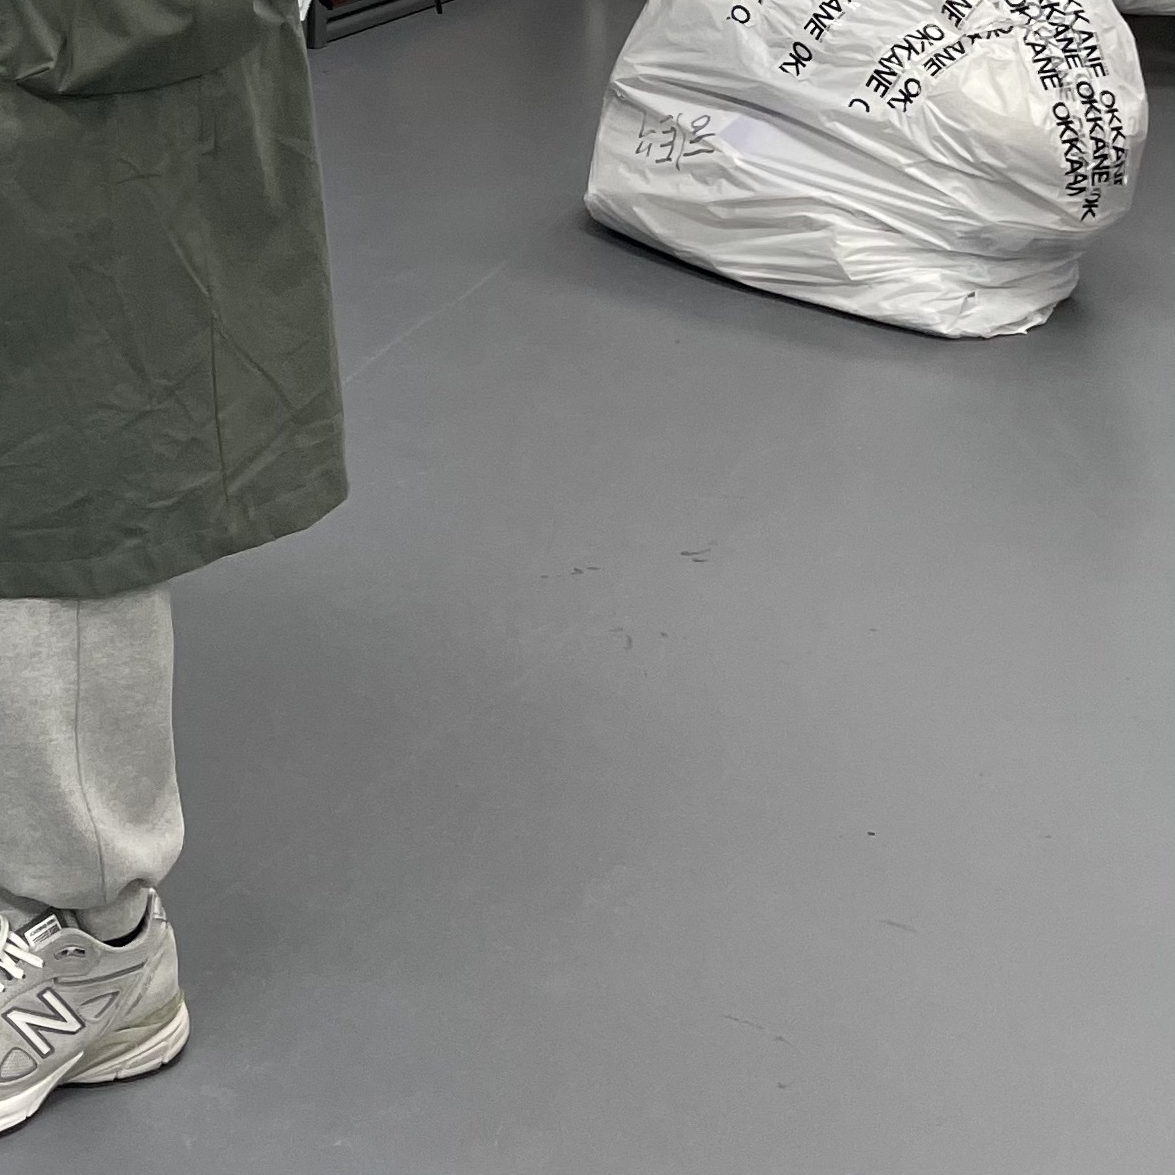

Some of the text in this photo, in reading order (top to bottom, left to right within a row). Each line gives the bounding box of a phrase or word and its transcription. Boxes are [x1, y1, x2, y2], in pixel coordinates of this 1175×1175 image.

[864, 23, 945, 99] OKKANE
[1075, 80, 1110, 187] OKKANE
[3, 988, 85, 1058] N
